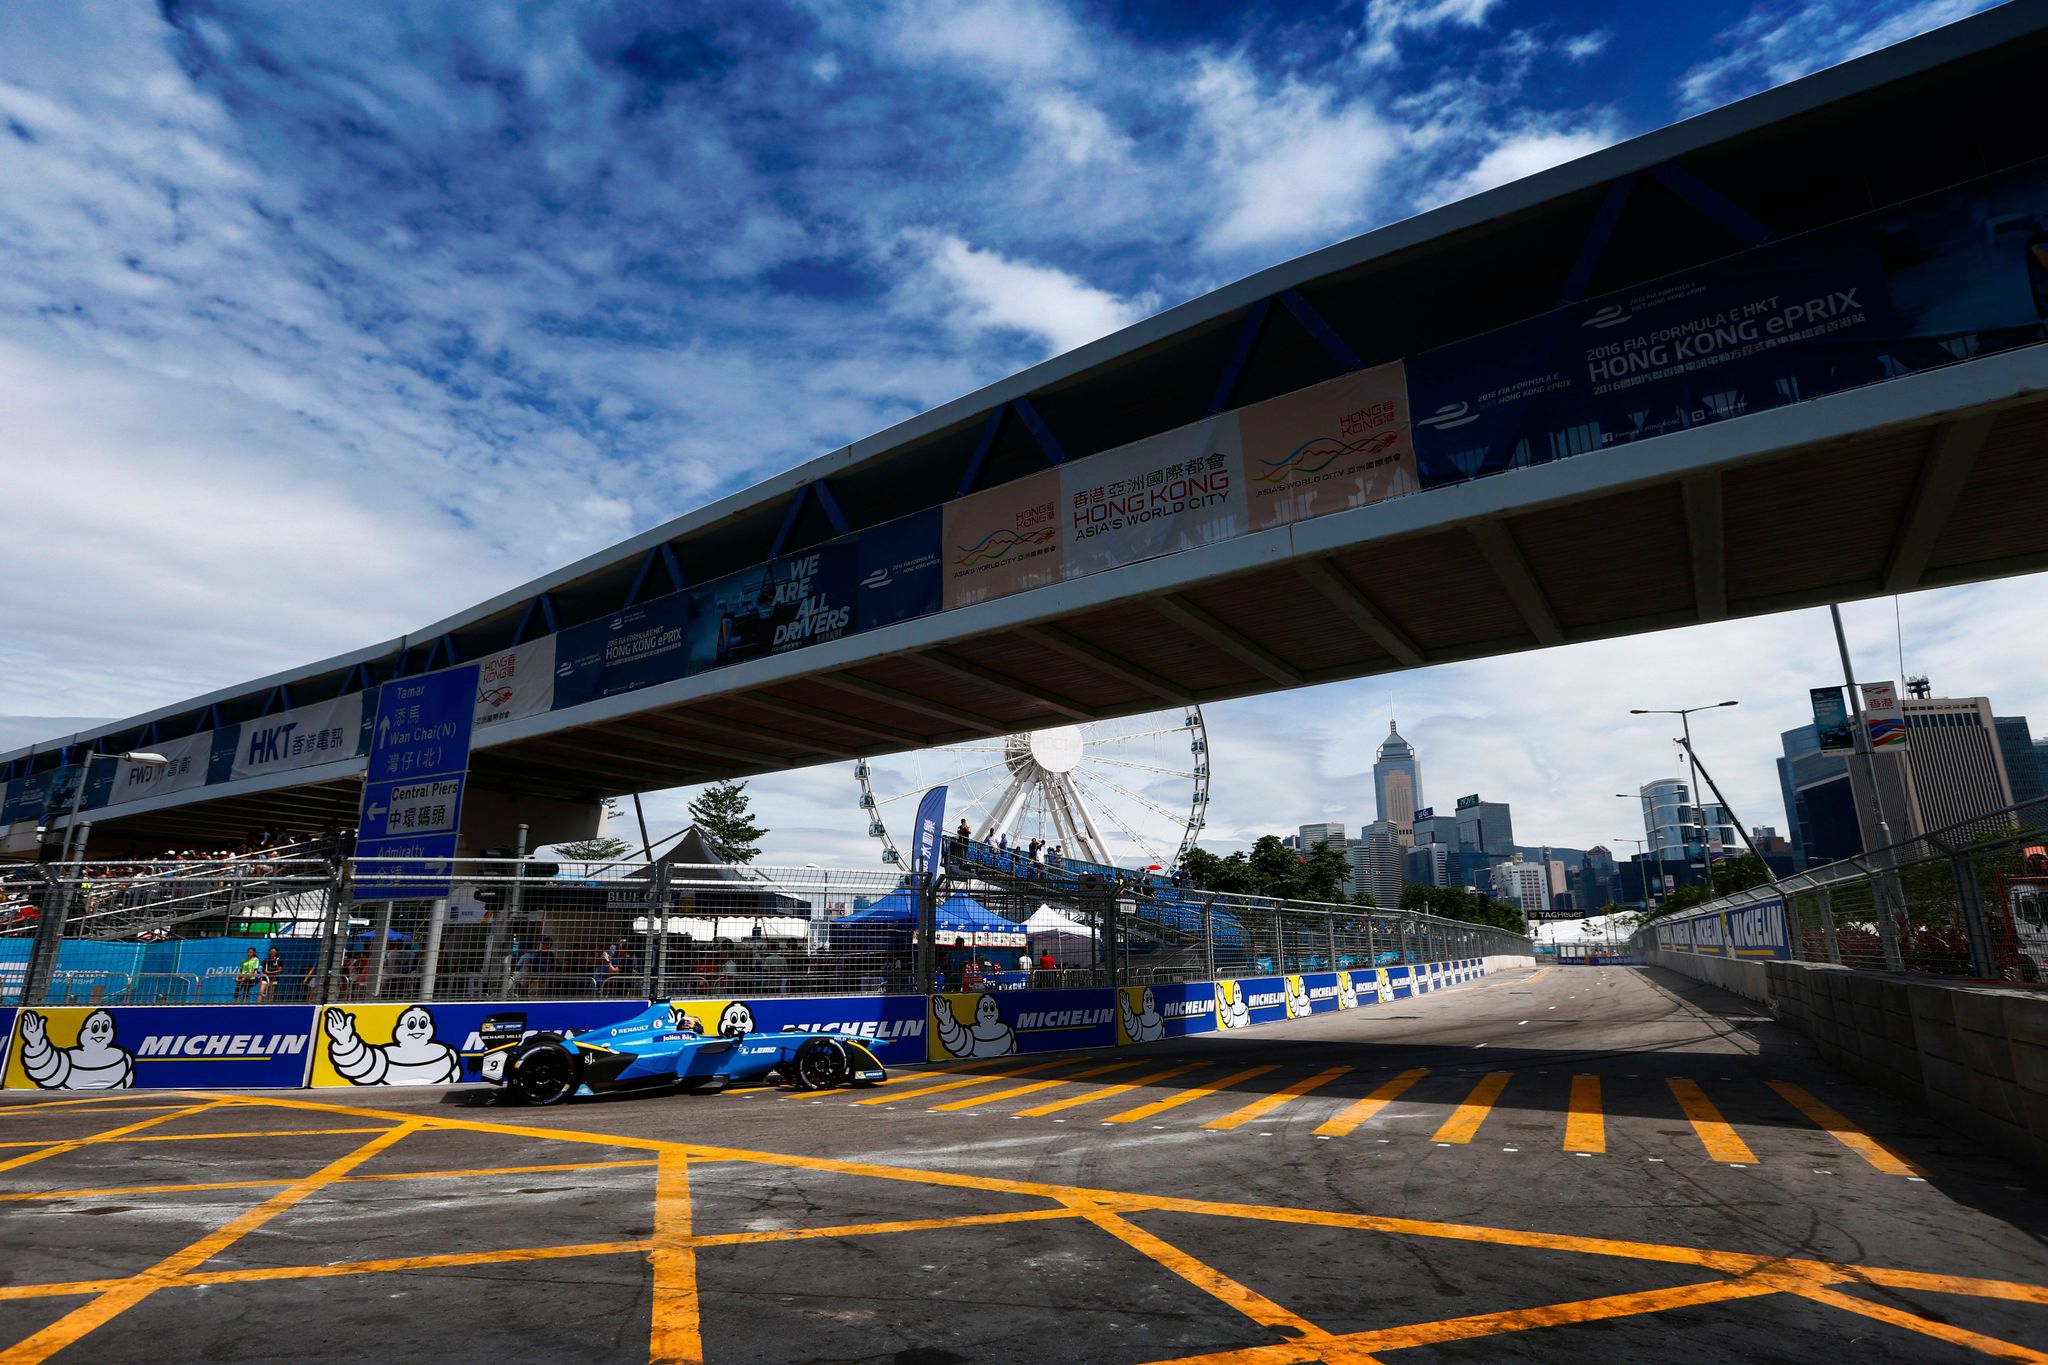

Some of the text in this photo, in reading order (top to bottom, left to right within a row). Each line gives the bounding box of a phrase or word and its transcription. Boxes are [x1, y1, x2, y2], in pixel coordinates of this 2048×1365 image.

[1585, 295, 1781, 362] 2016 FIA FORMULA E HKT
[1588, 287, 1863, 384] HONG KONG ePRIX
[1477, 391, 1497, 403] 2016
[1498, 386, 1511, 398] FIA
[1512, 376, 1552, 393] FORMULA
[1498, 392, 1522, 406] HONG
[1523, 386, 1546, 398] KONG
[1547, 379, 1573, 393] ePRIX
[1340, 404, 1382, 427] HONG
[1341, 414, 1383, 437] KONG
[1257, 484, 1285, 497] ASIA'S
[1287, 476, 1321, 489] WORLD
[1322, 469, 1346, 481] CITY
[1074, 470, 1229, 529] HONG KONG
[1016, 504, 1046, 522] HONG
[1016, 515, 1047, 530] KONG
[1076, 490, 1229, 542] ASIA'S WORLD CITY
[790, 553, 821, 581] WE
[954, 568, 975, 578] ASIA'S
[976, 562, 1000, 573] WORLD
[1001, 556, 1017, 566] CITY
[772, 577, 811, 607] ARE
[795, 592, 830, 621] ALL
[626, 629, 650, 643] FORMULA
[772, 605, 851, 646] DRIVERS
[605, 644, 631, 661] HONG
[632, 637, 657, 653] KONG
[658, 627, 682, 646] ePRIX
[484, 655, 508, 672] HONG
[483, 667, 508, 685] KONG
[397, 685, 426, 700] Tamar
[394, 704, 421, 727] 添馬
[249, 722, 344, 766] HKT 香港電訊
[390, 722, 457, 745] Wan Chai(N)
[387, 747, 442, 774] 灣仔(北)
[129, 766, 153, 786] FWD
[391, 782, 458, 801] Central Piers
[389, 804, 446, 831] 中環碼頭
[377, 843, 425, 857] Admiralty
[608, 891, 640, 902] BLUE
[1732, 905, 1785, 947] MICHELIN
[1310, 986, 1337, 998] MICHELIN
[1356, 981, 1377, 992] MICHELIN
[1164, 999, 1215, 1017] MICHELIN
[1248, 991, 1286, 1006] MICHELIN
[618, 1024, 649, 1035] RENAULT
[1016, 1008, 1115, 1030] MICHELIN
[137, 1034, 309, 1056] MICHELIN
[751, 1046, 776, 1054] LEMO
[490, 1060, 498, 1071] 9
